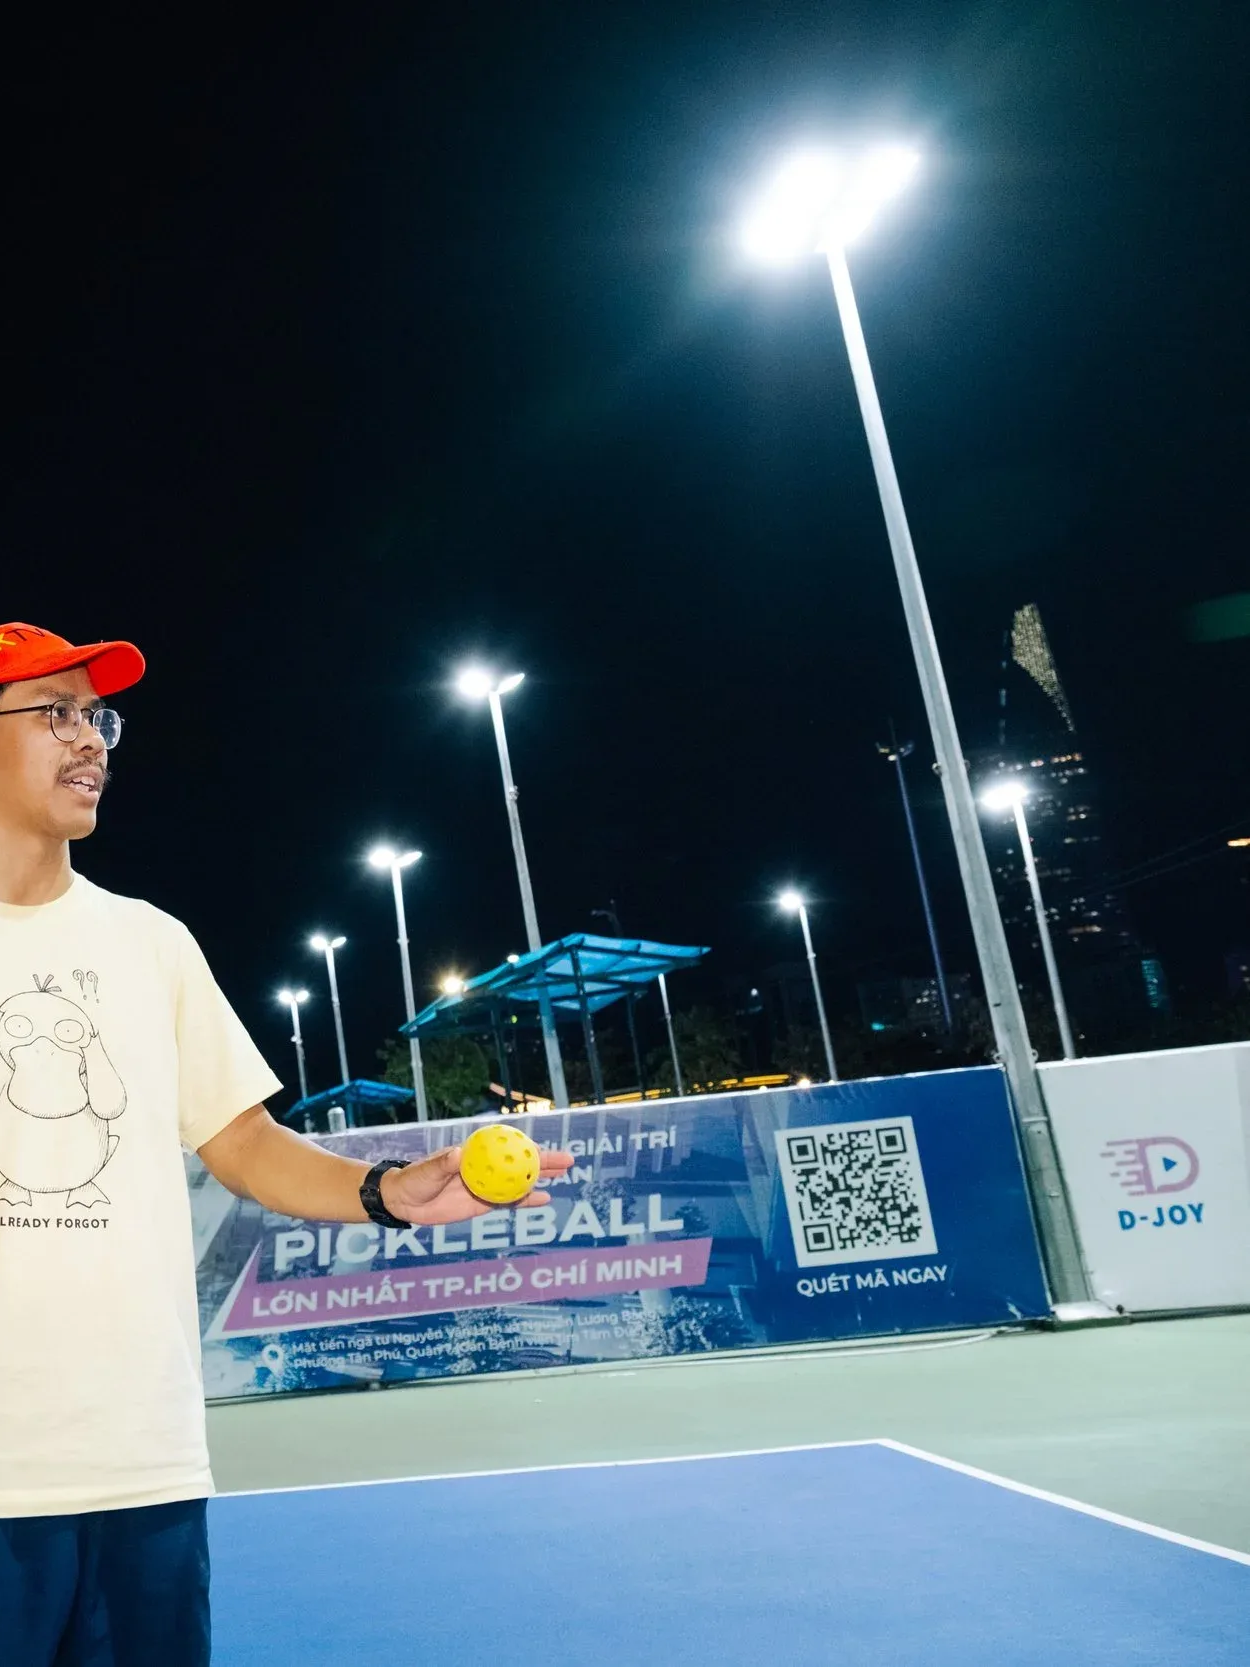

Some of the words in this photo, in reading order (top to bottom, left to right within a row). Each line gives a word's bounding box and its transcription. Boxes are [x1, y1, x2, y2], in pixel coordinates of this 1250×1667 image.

[567, 1132, 623, 1158] GIẢI
[629, 1125, 678, 1151] TRÍ
[56, 1218, 110, 1229] FORGOT
[273, 1193, 684, 1272] PICKLEBALL
[1118, 1202, 1204, 1231] D-JOY
[252, 1289, 318, 1318] LỚN
[326, 1275, 416, 1309] NHẤT
[530, 1259, 588, 1289] CHÍ
[596, 1255, 683, 1282] MINH
[796, 1272, 851, 1298] QUÉT
[855, 1268, 890, 1290] MÃ
[892, 1264, 948, 1287] NGAY
